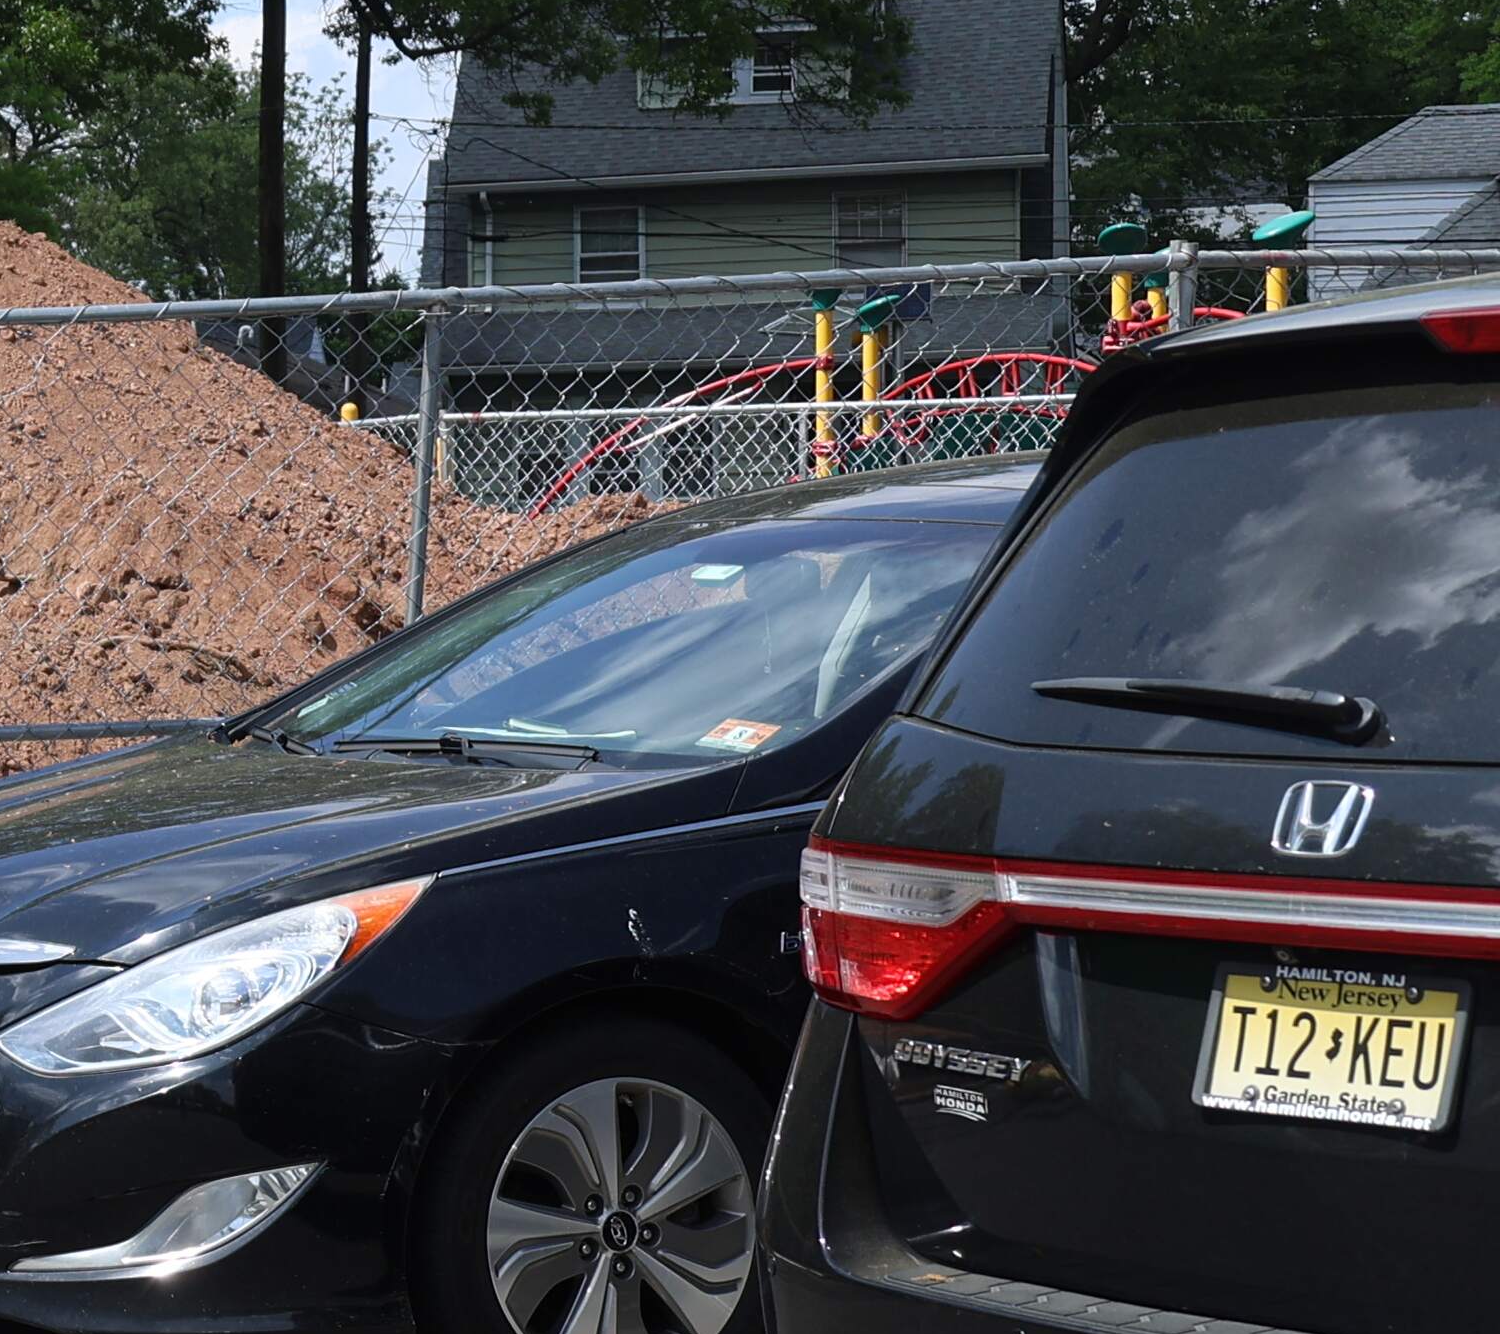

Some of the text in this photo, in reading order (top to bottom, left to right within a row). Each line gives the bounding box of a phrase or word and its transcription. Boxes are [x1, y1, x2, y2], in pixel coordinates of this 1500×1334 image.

[1277, 979, 1404, 1012] New Jersey
[1382, 973, 1407, 988] NJ
[894, 1037, 1032, 1083] ODYSSEY
[1232, 1005, 1446, 1091] T12 KEU
[934, 1087, 984, 1104] HAMILTON
[934, 1095, 986, 1114] HONDA
[1263, 1084, 1389, 1114] Garden State
[1201, 1093, 1434, 1132] www.hamiltonhonda.net
